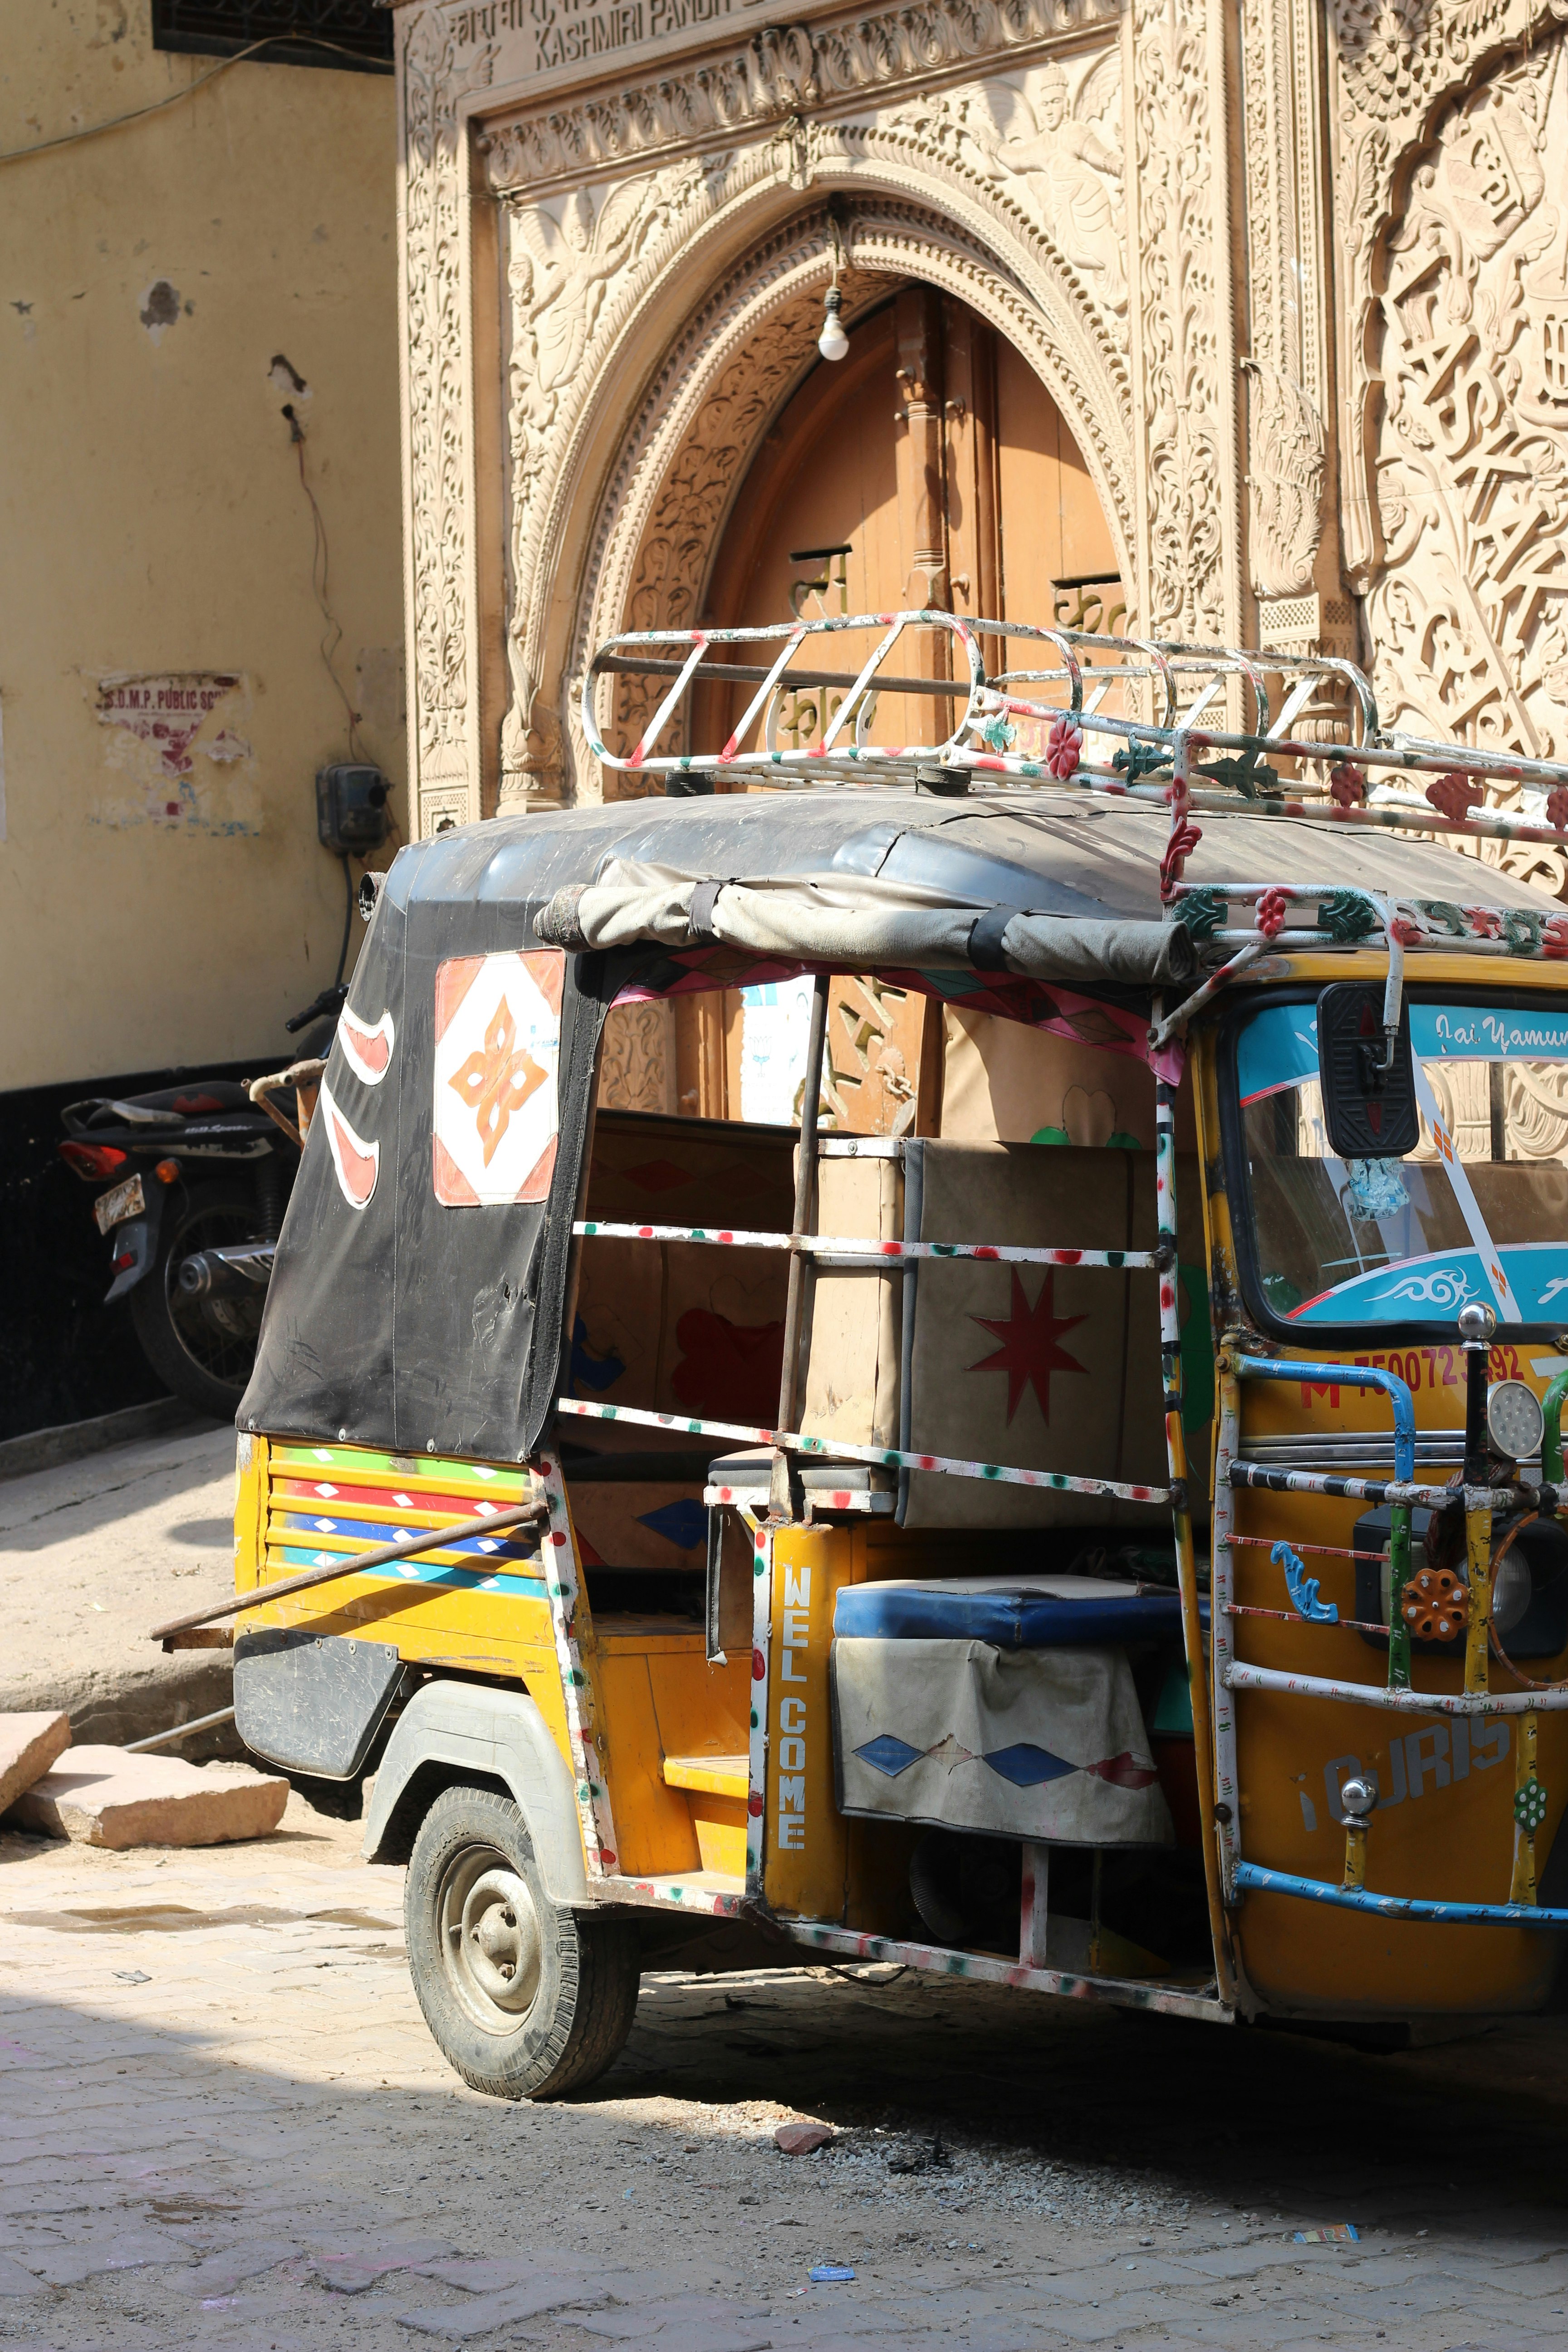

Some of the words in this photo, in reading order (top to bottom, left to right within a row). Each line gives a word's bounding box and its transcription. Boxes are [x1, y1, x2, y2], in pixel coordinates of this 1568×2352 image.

[535, 3, 643, 71] KASHMIRI
[158, 689, 197, 709] PUBLIC
[1436, 1014, 1480, 1054] Jai
